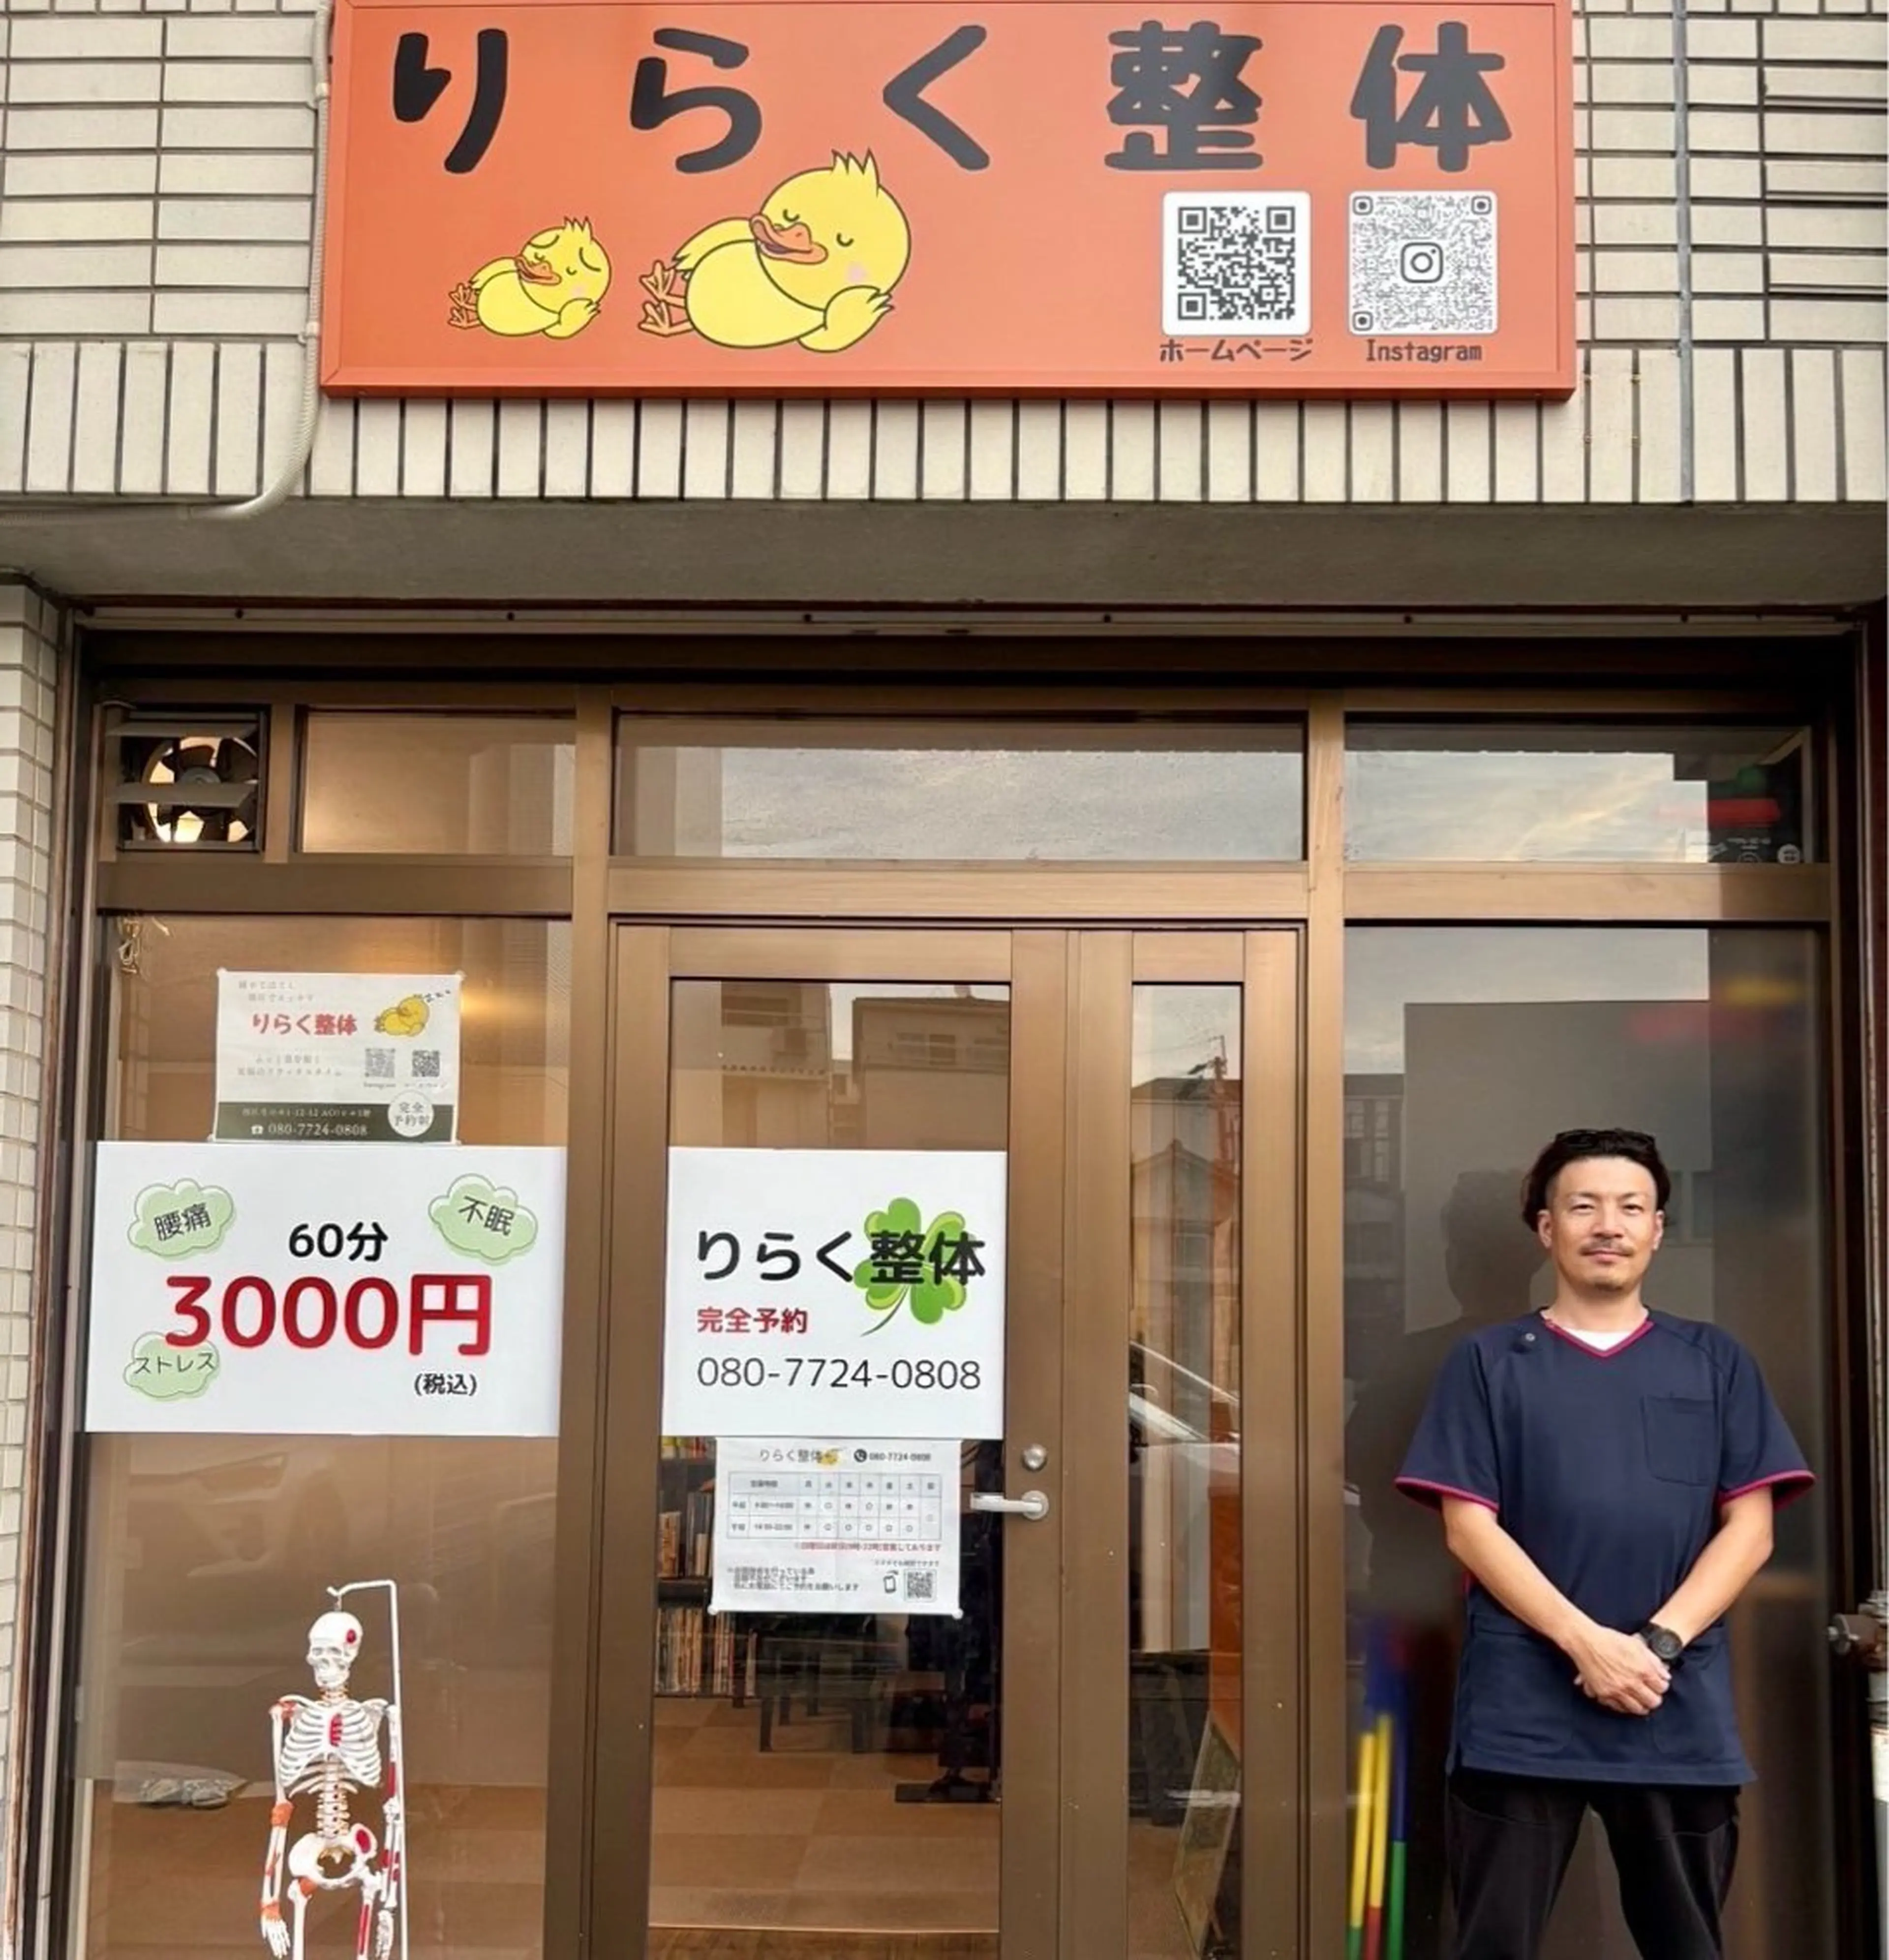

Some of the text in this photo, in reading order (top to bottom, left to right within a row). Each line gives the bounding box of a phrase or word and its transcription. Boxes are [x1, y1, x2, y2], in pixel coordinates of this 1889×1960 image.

[393, 20, 1512, 173] りらく整体
[1159, 338, 1313, 362] ホームページ
[1367, 339, 1482, 363] Instagram
[252, 1013, 358, 1036] りらく整体
[153, 1202, 212, 1241] 腰痛
[458, 1195, 515, 1236] 不眠
[289, 1222, 389, 1262] 60分
[698, 1229, 986, 1286] りらく整体
[165, 1274, 492, 1355] 3000円
[697, 1307, 808, 1334] 完全予約
[134, 1352, 215, 1375] ストレス
[698, 1357, 981, 1390] 080-7724-0808
[414, 1373, 477, 1396] (税込)
